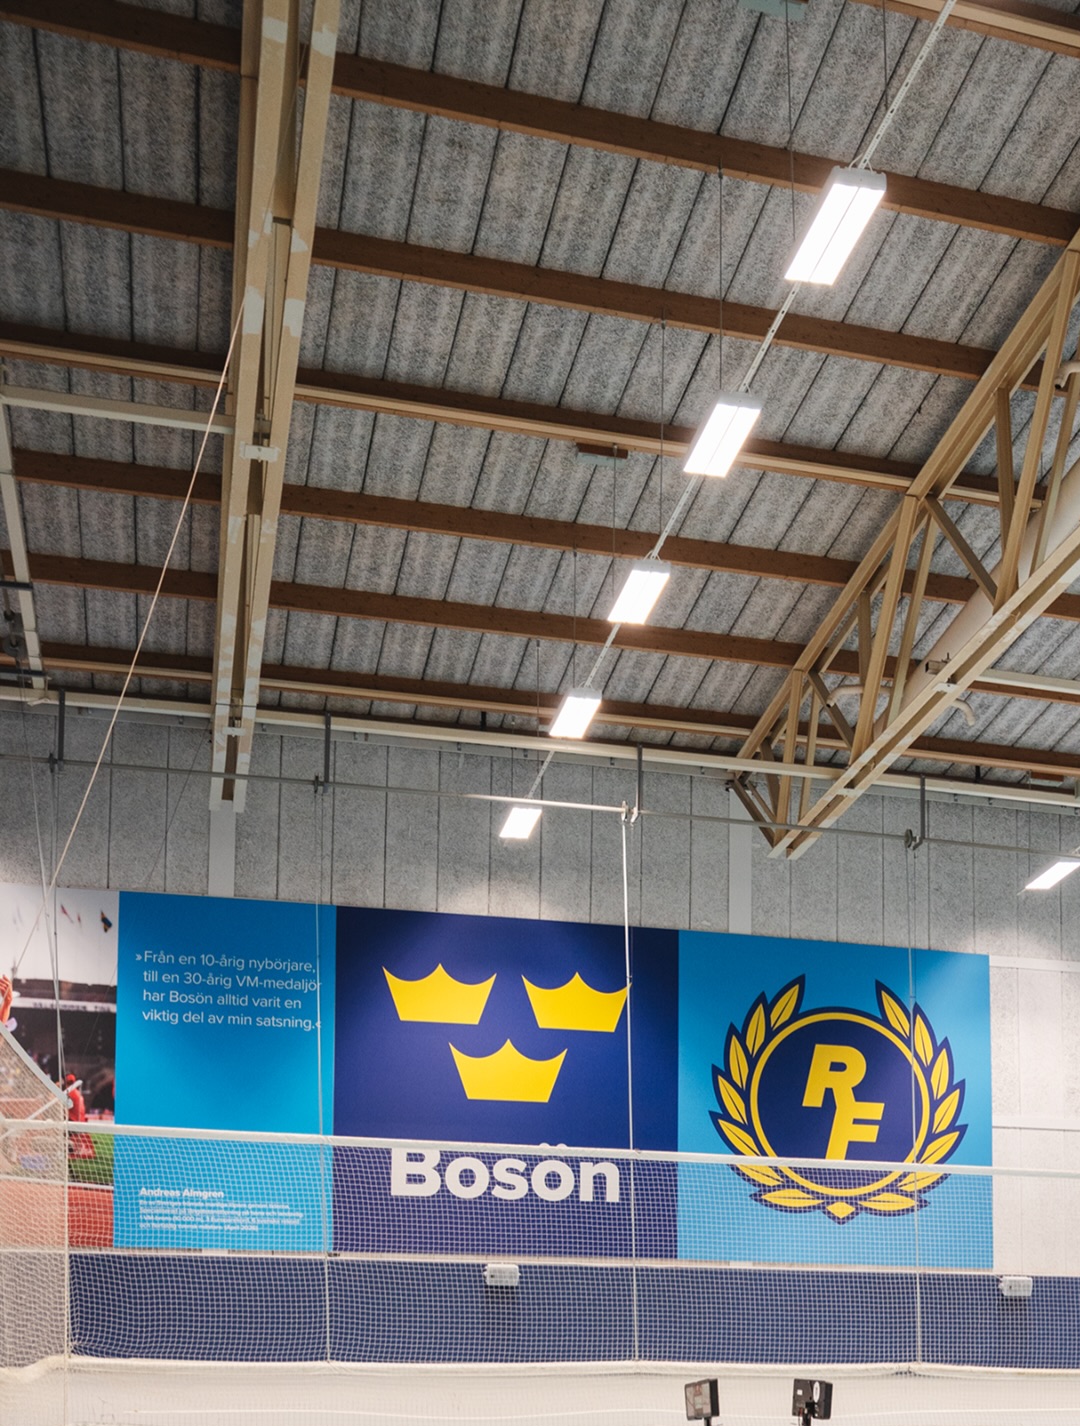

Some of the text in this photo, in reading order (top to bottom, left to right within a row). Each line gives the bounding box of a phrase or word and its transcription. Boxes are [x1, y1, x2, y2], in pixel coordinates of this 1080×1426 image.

[179, 955, 196, 965] en
[200, 954, 245, 972] 10-årig
[249, 957, 316, 974] nybörjare,
[143, 971, 321, 993] till en 30-årig VM-medaljör
[143, 989, 301, 1009] har Bosön alltid varit en
[142, 1009, 179, 1024] viktig
[183, 1011, 204, 1023] del
[208, 1014, 224, 1024] av
[228, 1014, 252, 1025] min
